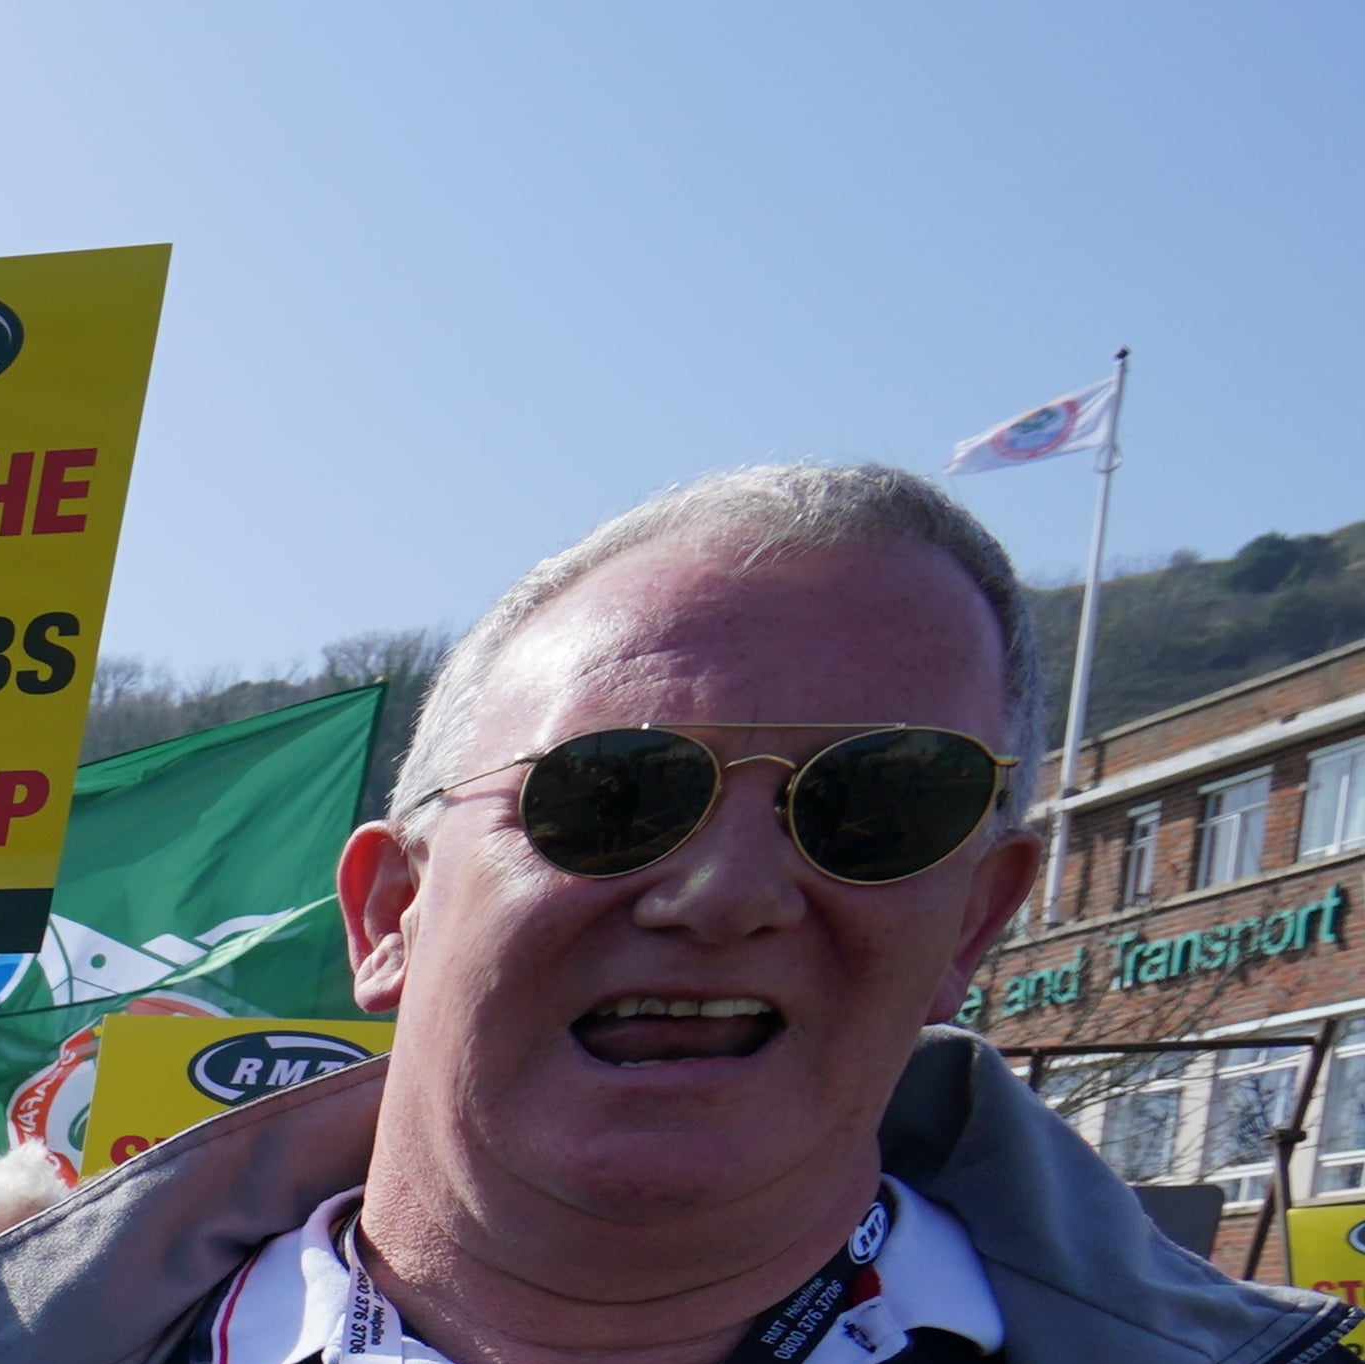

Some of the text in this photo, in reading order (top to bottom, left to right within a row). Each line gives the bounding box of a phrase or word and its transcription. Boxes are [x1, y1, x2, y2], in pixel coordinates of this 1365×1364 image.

[1001, 948, 1086, 1017] and
[1105, 884, 1344, 990] Transport
[349, 1323, 367, 1354] 3706
[353, 1296, 369, 1321] 376
[761, 1277, 825, 1345] RMT Helpline
[773, 1279, 843, 1360] 0800 376 3706
